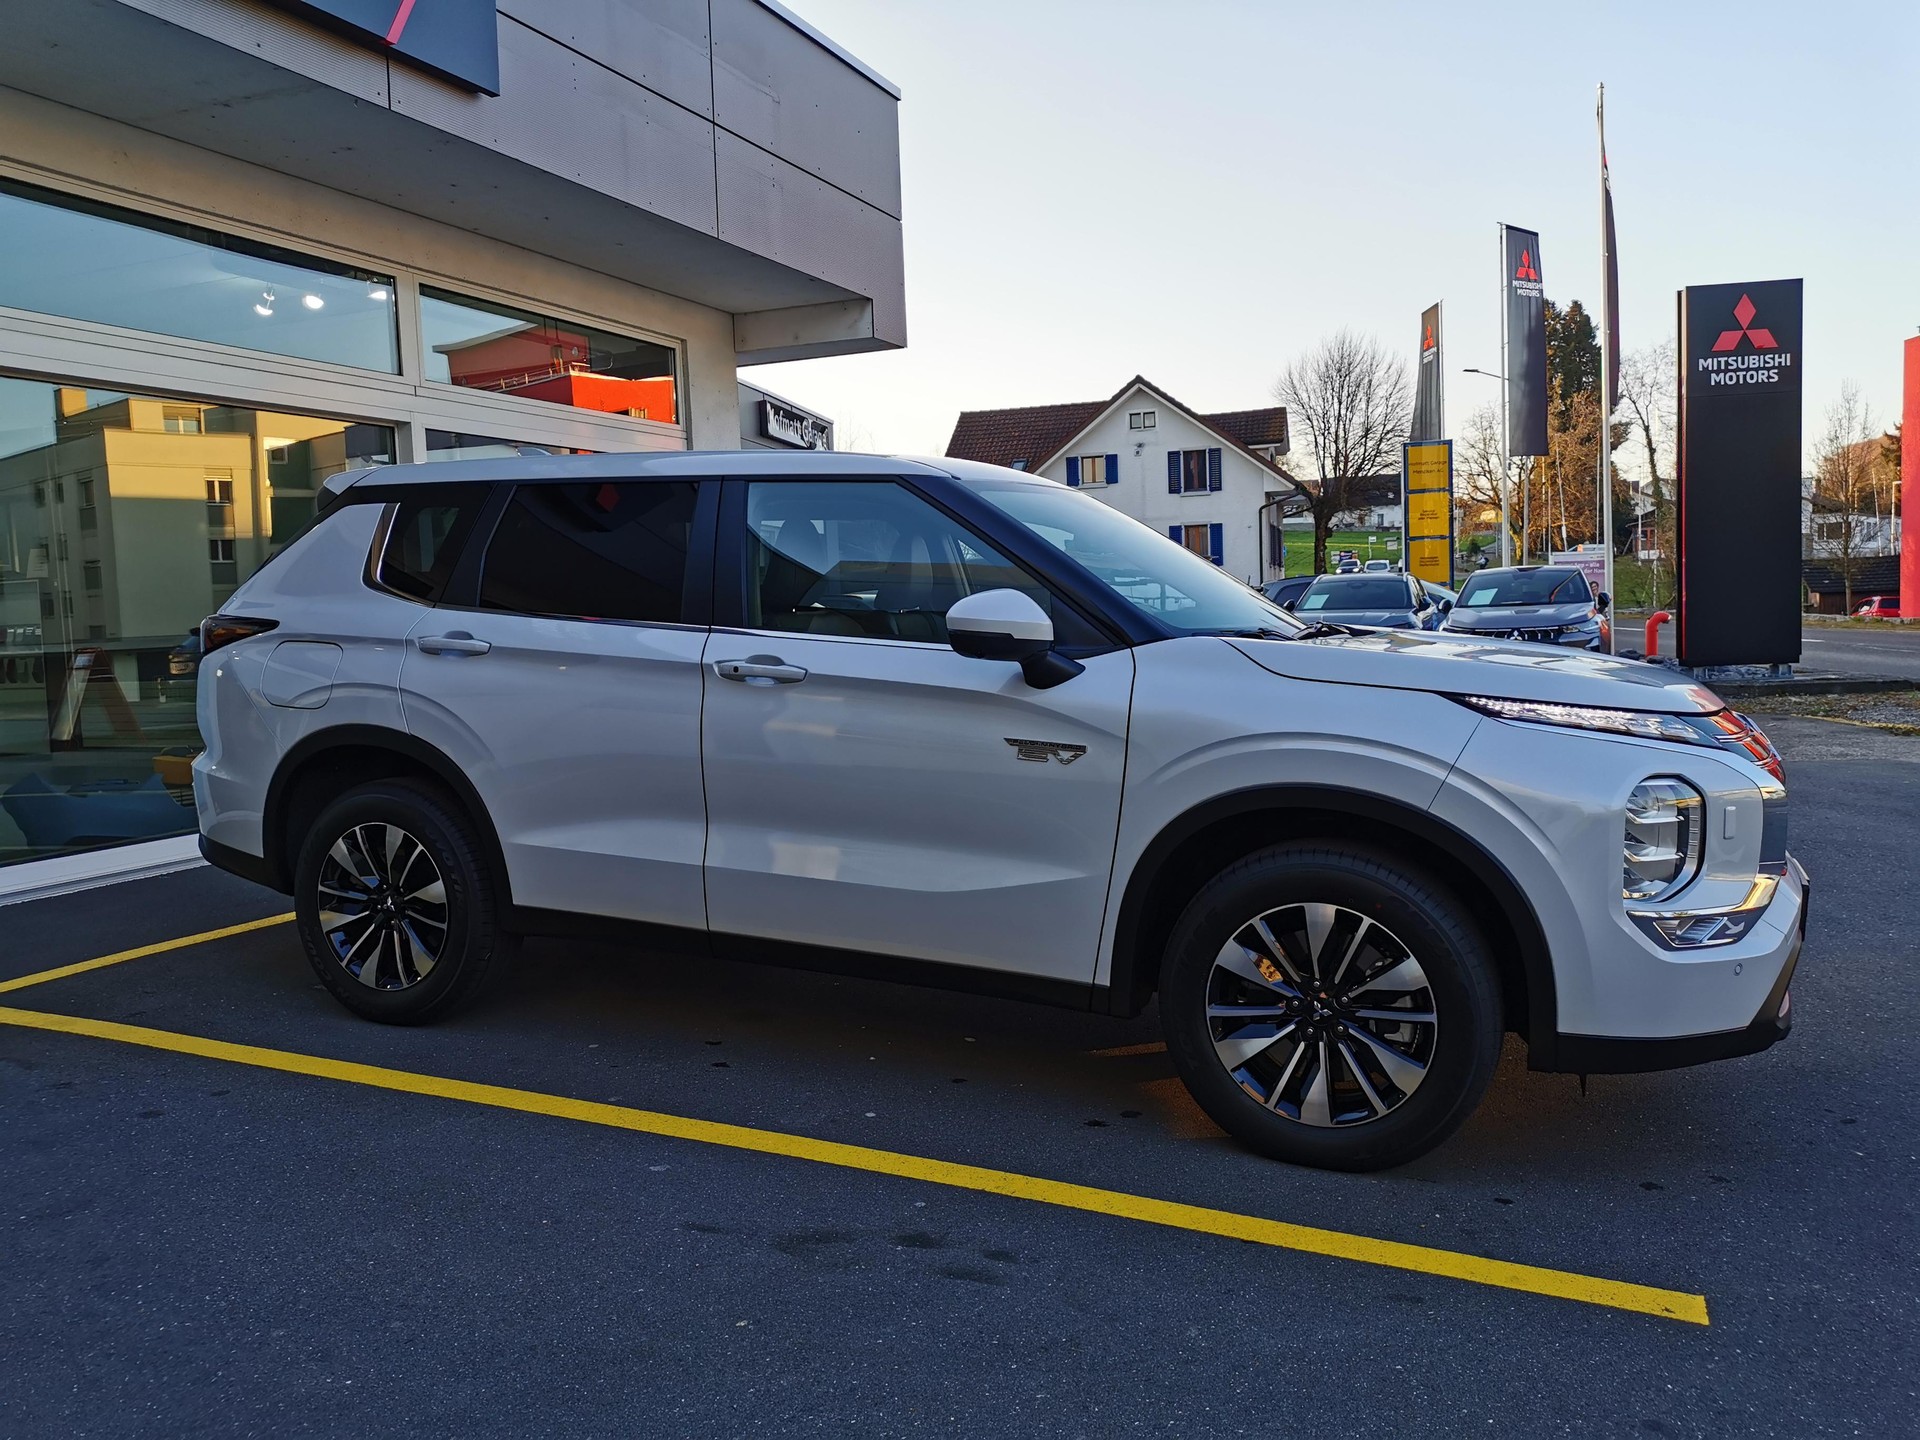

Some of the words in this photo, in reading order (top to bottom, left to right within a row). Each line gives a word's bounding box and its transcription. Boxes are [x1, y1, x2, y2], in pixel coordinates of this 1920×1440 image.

[1517, 289, 1540, 297] MOTORS
[1698, 353, 1791, 371] MITSUBISHI
[1710, 369, 1779, 386] MOTORS
